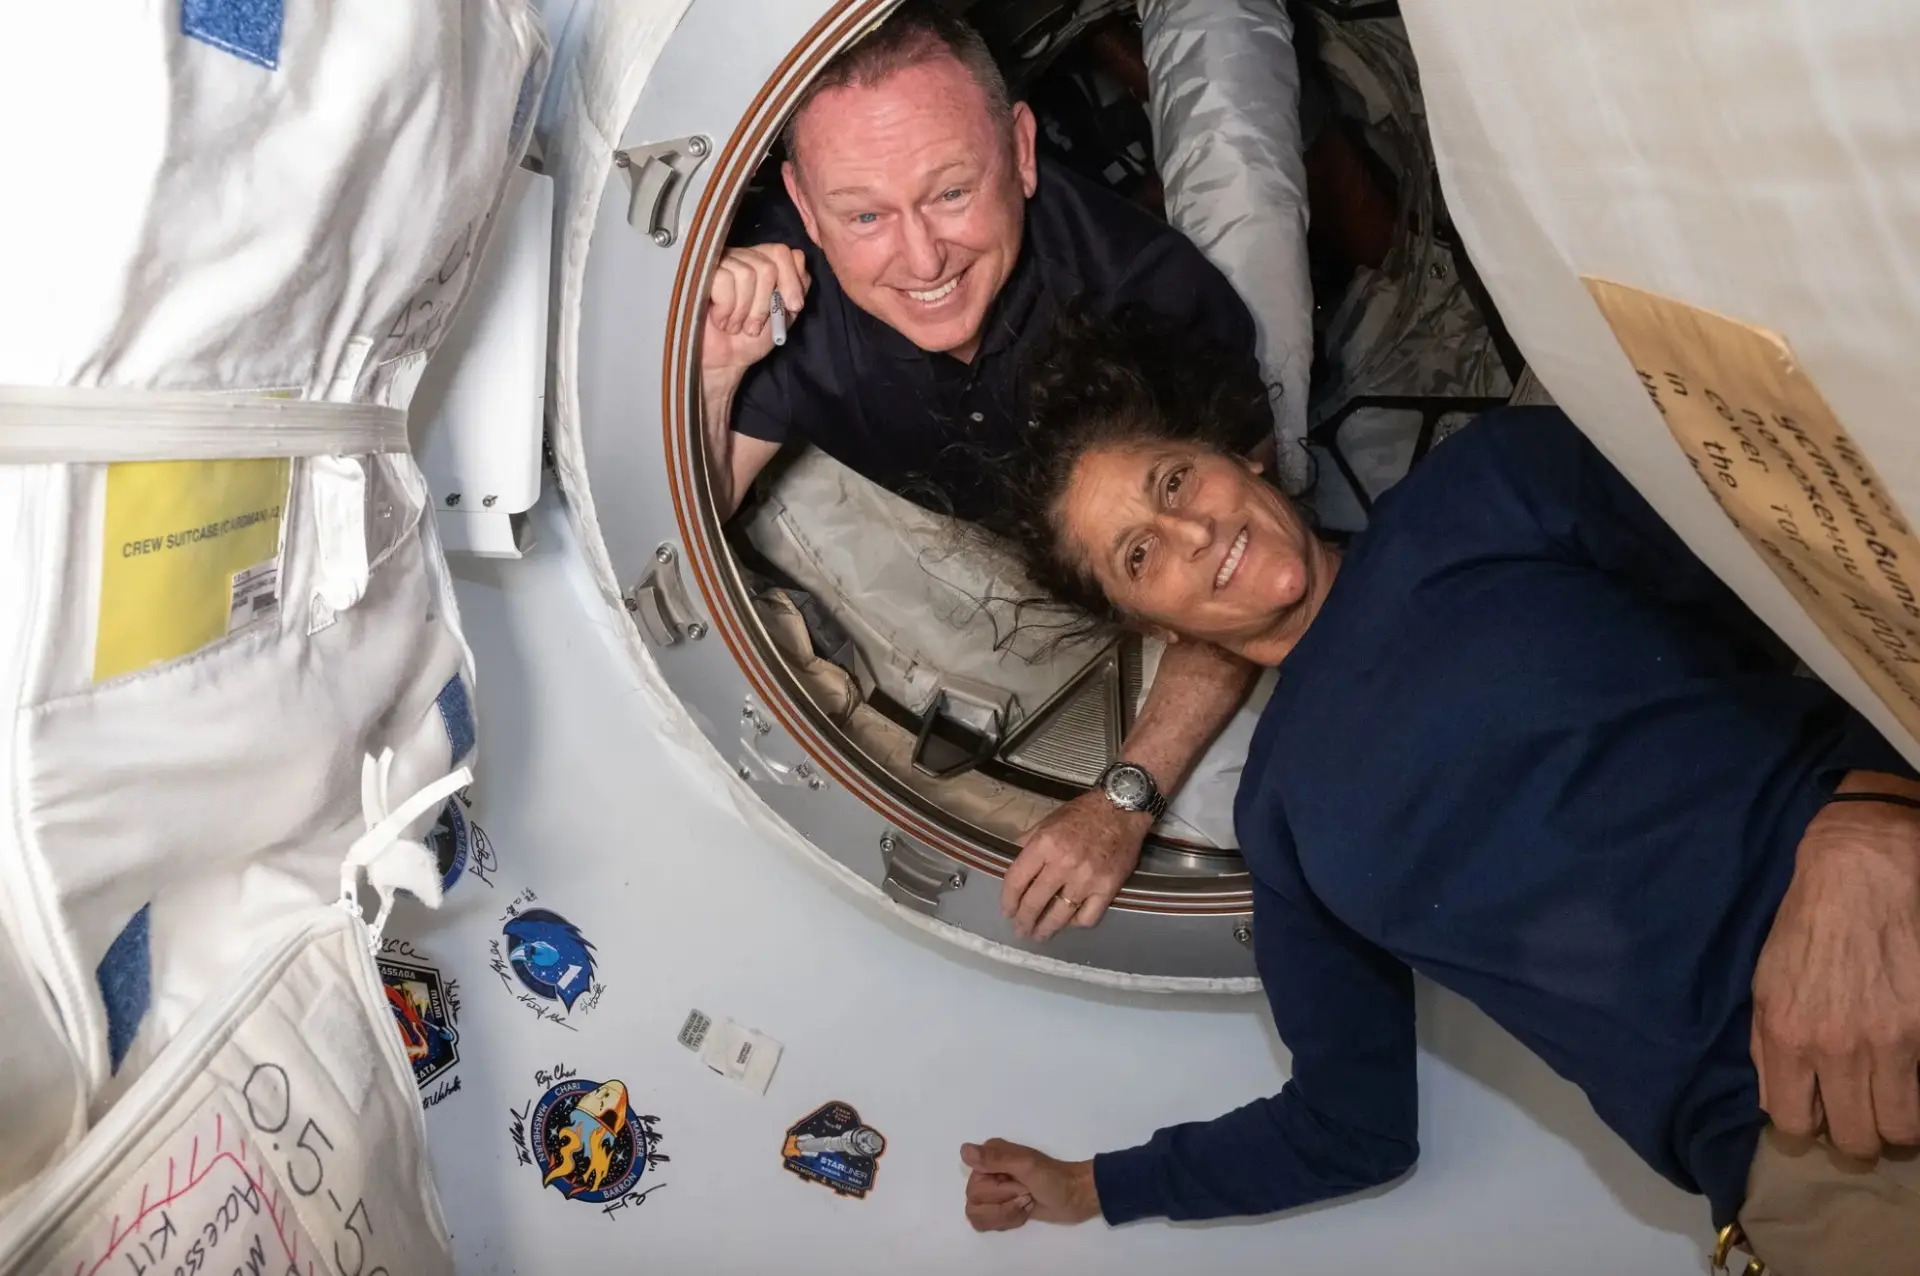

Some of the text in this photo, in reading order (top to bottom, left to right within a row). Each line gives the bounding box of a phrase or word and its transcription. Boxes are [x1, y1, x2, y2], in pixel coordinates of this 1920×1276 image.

[1663, 371, 1689, 397] in
[1703, 440, 1739, 489] the
[1704, 387, 1770, 474] cover
[1771, 412, 1920, 618] установить
[122, 536, 164, 557] CREW
[166, 522, 220, 549] SUITCASE
[377, 964, 417, 980] ASSADA
[554, 1082, 581, 1097] CHARI
[534, 1102, 549, 1163] MARSHBURN
[630, 1119, 645, 1158] MAURER
[602, 1172, 638, 1199] BARRON
[820, 1156, 869, 1180] STARLINER
[831, 1179, 861, 1195] WILLIAMS
